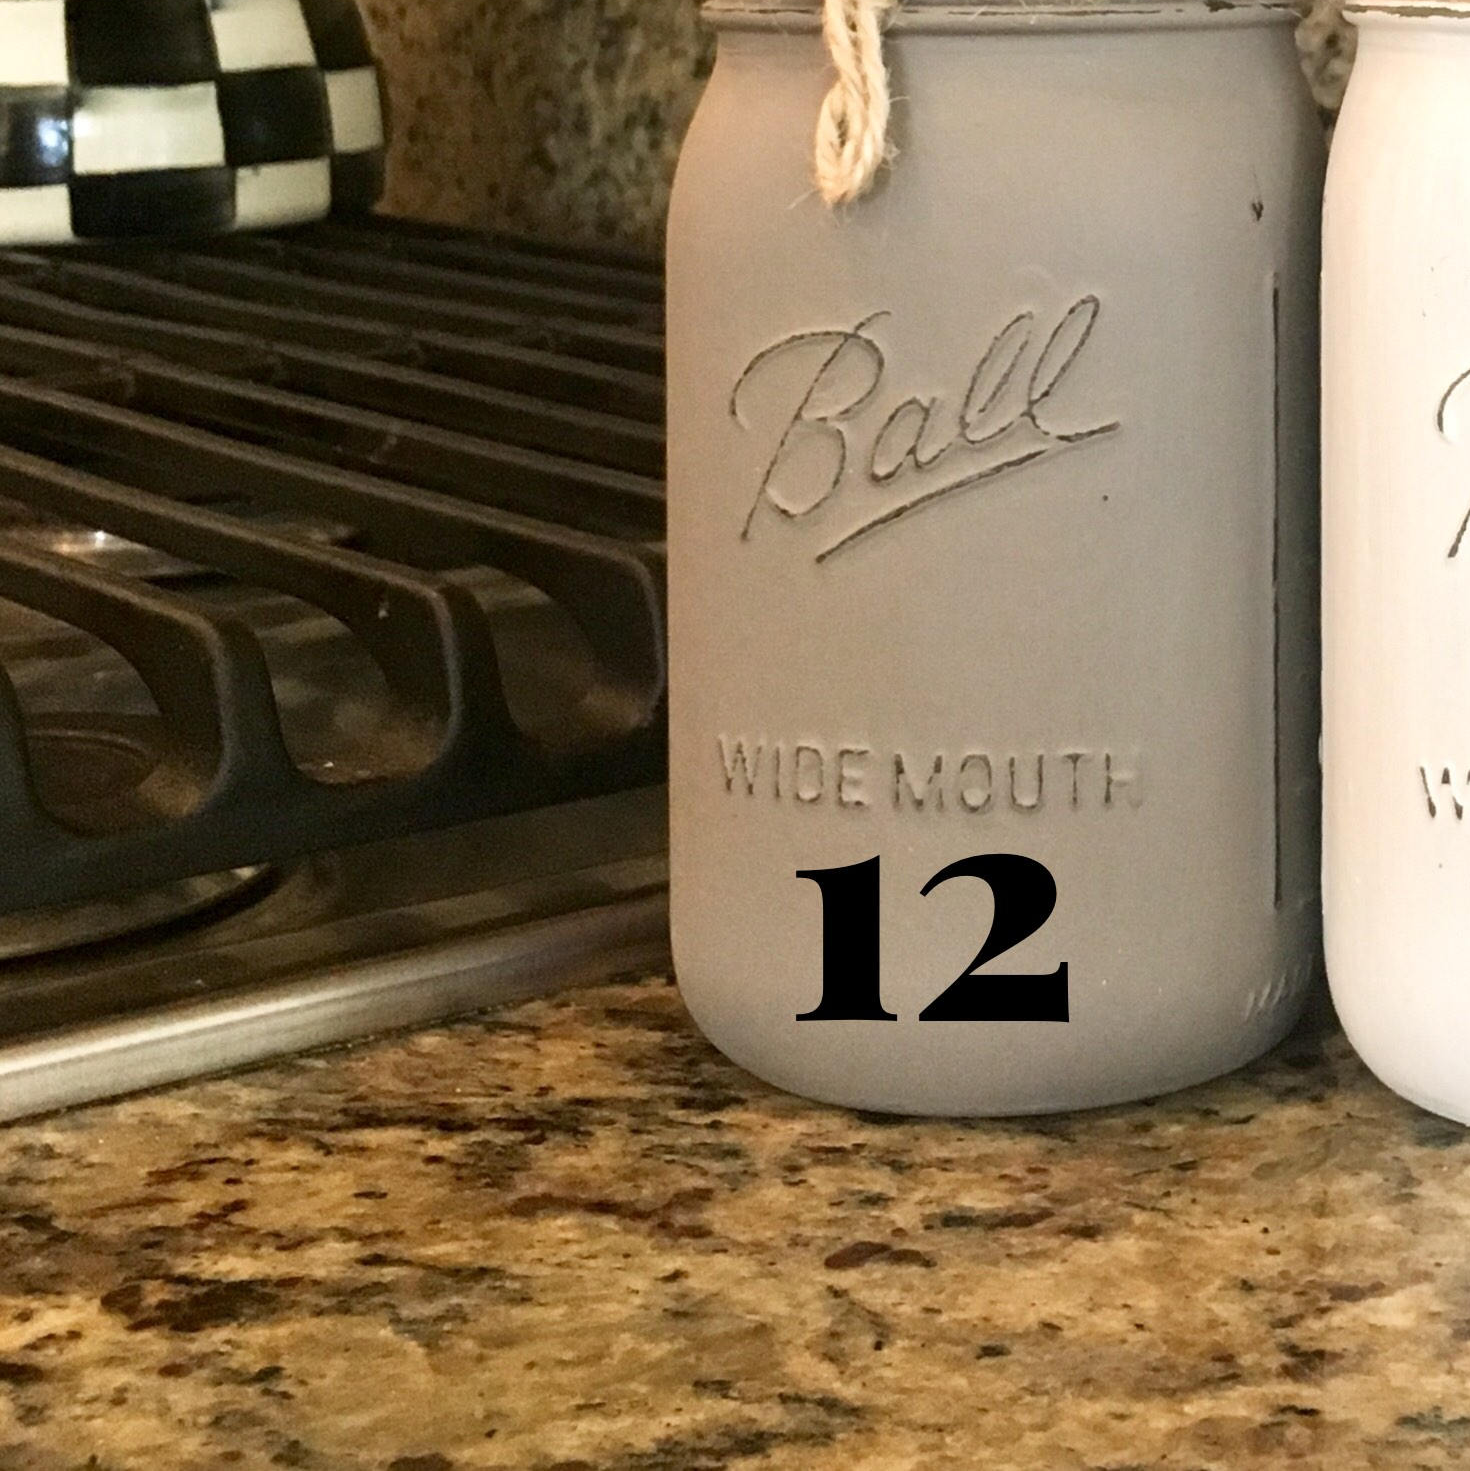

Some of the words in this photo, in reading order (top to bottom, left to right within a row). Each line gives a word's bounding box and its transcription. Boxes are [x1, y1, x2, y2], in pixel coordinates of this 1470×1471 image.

[730, 294, 1121, 554] Ball
[717, 734, 871, 808] WIDE
[891, 747, 1144, 814] MOUTH
